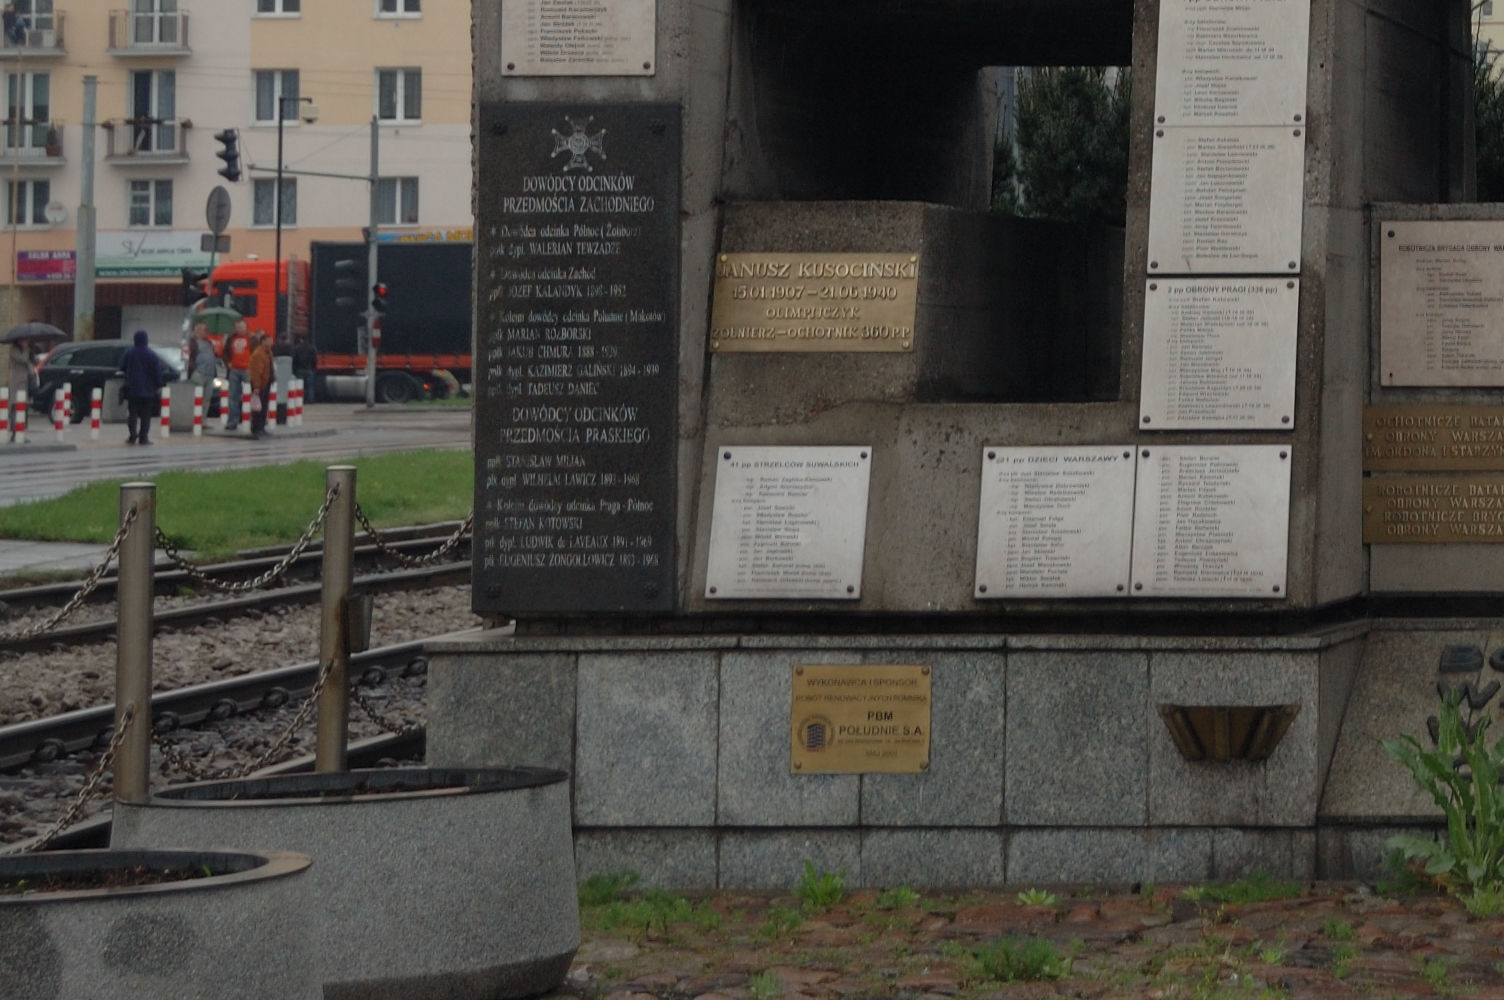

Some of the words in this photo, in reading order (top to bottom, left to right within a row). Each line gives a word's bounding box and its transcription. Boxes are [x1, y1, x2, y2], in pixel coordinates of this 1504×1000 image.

[523, 174, 576, 192] DOWÓDCY
[578, 173, 635, 191] ODCINKÓW
[503, 193, 574, 213] PRZEDMOŚCIA
[579, 196, 654, 213] ZACHODNIEGO
[529, 242, 573, 255] WALERIAN
[720, 263, 790, 279] JANUSZ
[861, 325, 889, 338] 360
[513, 404, 570, 423] DOWÓDCY
[574, 403, 638, 422] ODCINKÓW
[1377, 416, 1461, 427] OCHOTNICZE
[500, 425, 580, 443] PRZEDMOŚCIA
[586, 427, 650, 443] PRASKIEGO
[1386, 431, 1438, 442] OBRONY
[754, 461, 804, 469] STRZELCÓW
[1028, 456, 1058, 464] DZIECI
[1063, 455, 1119, 463] WARSZAWY
[1377, 485, 1456, 496] ROBOTNICZE
[1387, 497, 1439, 509] OBRONY
[1384, 511, 1464, 522] ROBOTNICZE
[1387, 524, 1439, 536] OBRONY
[867, 711, 893, 721] PBM
[839, 725, 900, 735] POŁUDNIE
